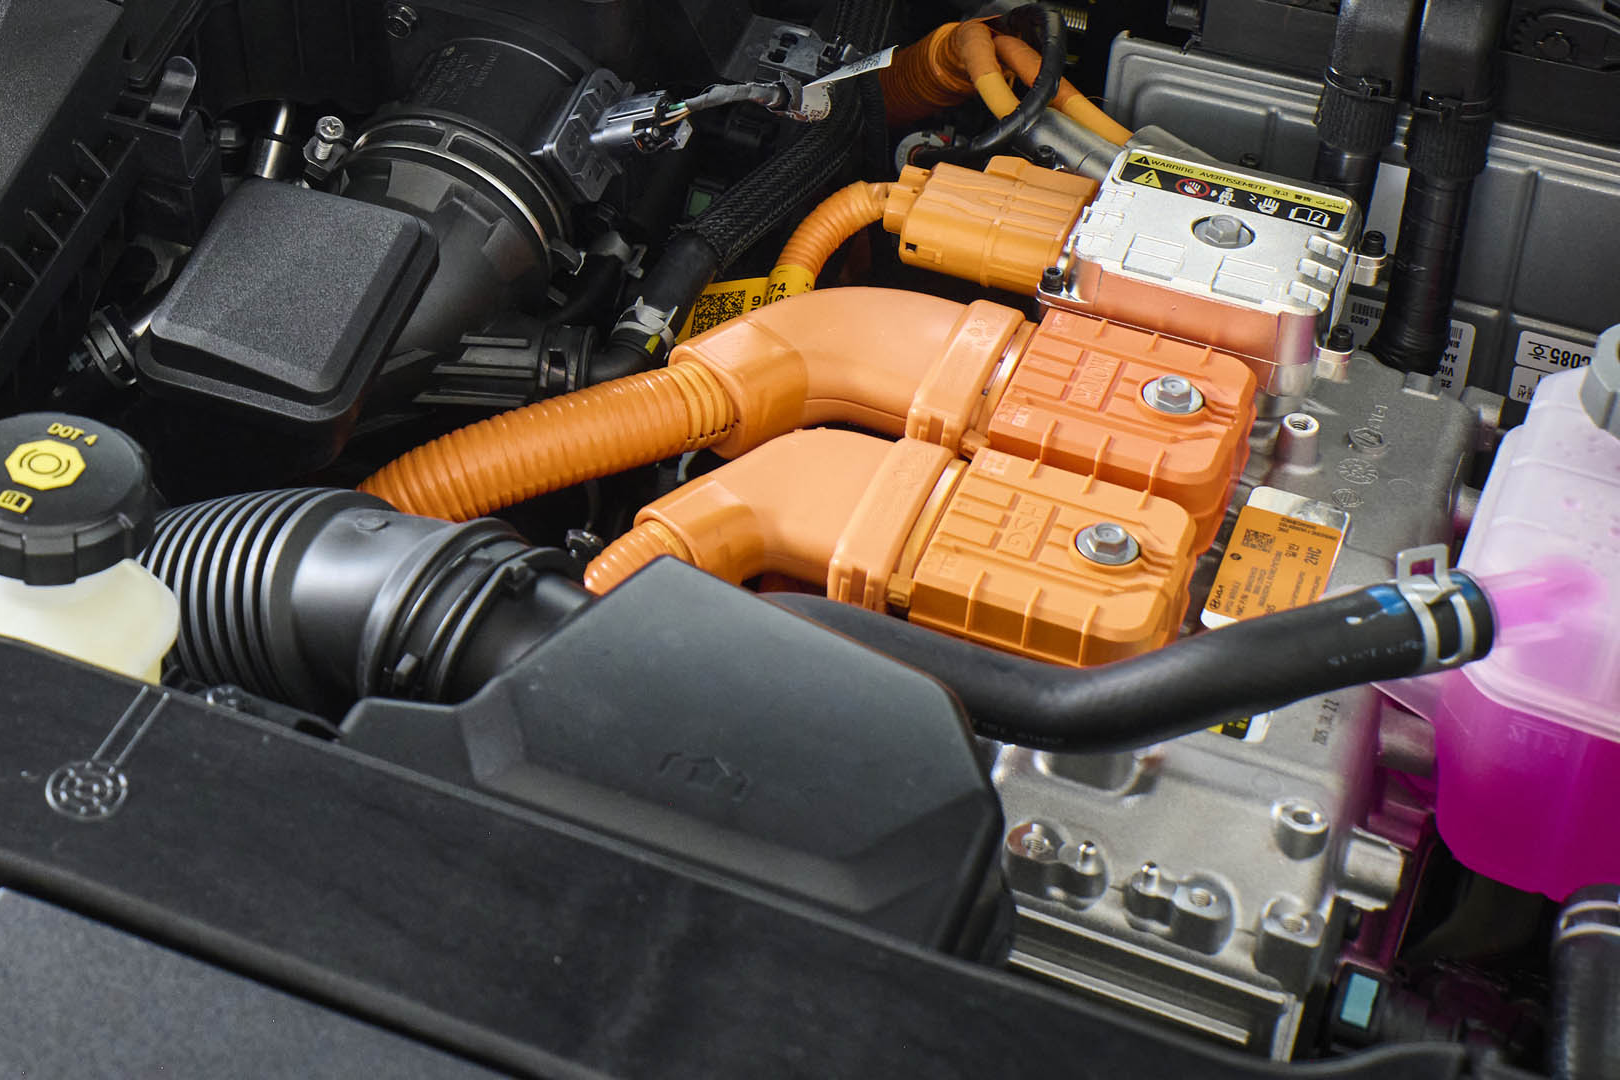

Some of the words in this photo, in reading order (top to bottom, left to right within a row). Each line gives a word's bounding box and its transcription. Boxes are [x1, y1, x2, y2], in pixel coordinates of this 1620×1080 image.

[1151, 159, 1194, 174] WARNING
[1200, 171, 1268, 191] AVERTISSEMENT
[47, 422, 84, 441] DOT
[84, 434, 99, 446] 4
